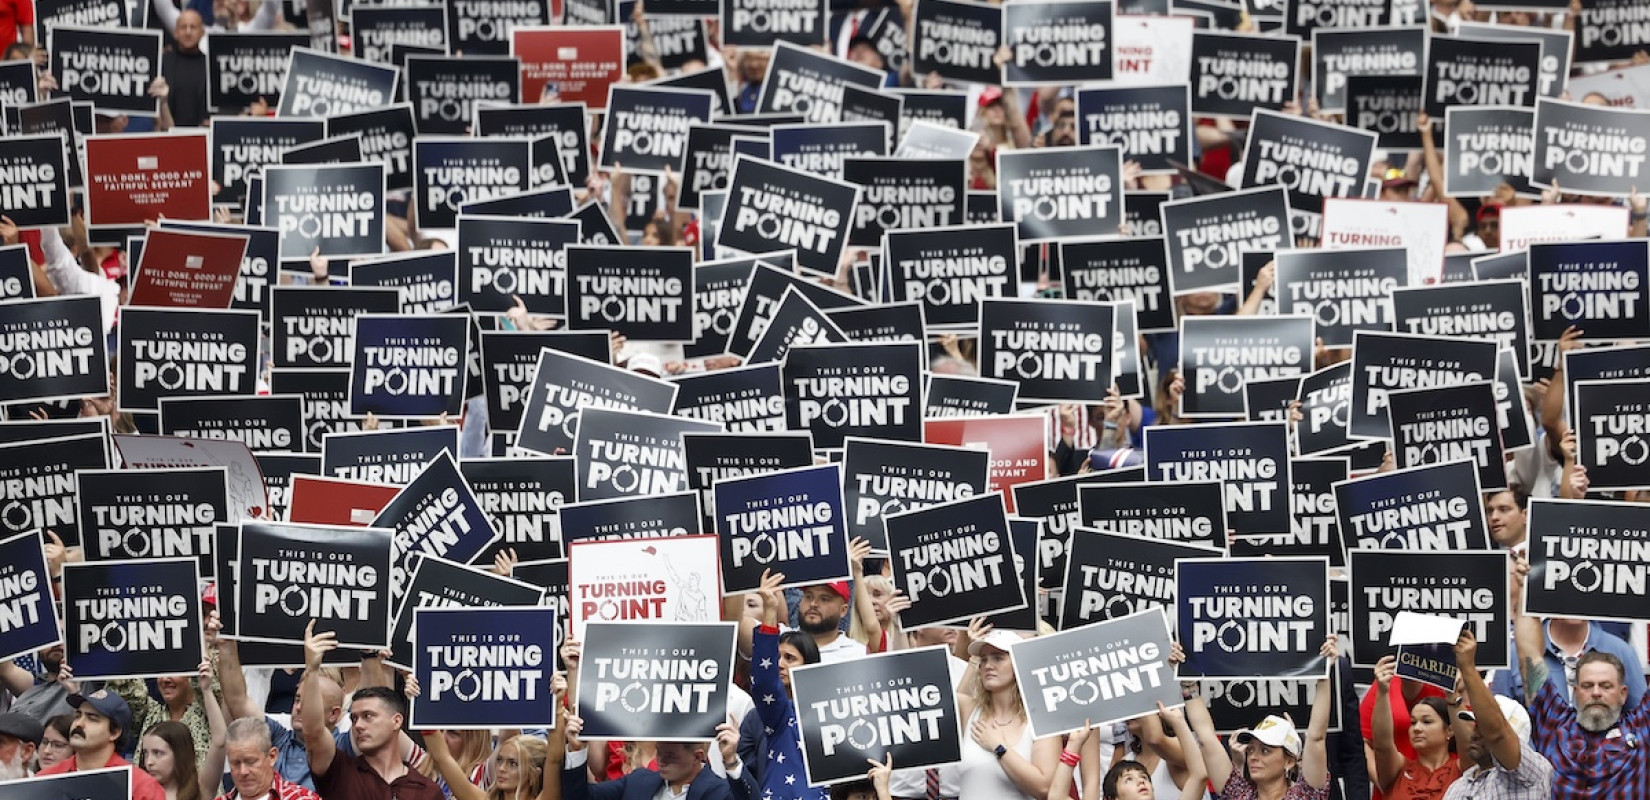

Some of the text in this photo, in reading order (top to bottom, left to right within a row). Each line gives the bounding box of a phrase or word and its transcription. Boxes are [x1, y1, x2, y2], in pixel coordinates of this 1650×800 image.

[454, 0, 541, 18] TURNING
[733, 9, 818, 33] POINT
[920, 21, 996, 46] TURNING
[1013, 24, 1104, 43] TURNING
[60, 52, 149, 73] TURNING
[920, 38, 995, 70] POINT
[1017, 42, 1105, 66] POINT
[1323, 51, 1417, 71] TURNING
[1199, 57, 1288, 78] TURNING
[1435, 64, 1530, 82] TURNING
[62, 70, 149, 97] POINT
[296, 74, 382, 107] TURNING
[417, 82, 510, 98] TURNING
[1199, 75, 1287, 103] POINT
[1437, 80, 1529, 104] POINT
[1086, 110, 1179, 131] TURNING
[1545, 129, 1647, 154] TURNING
[1259, 140, 1359, 175] TURNING
[1545, 147, 1646, 180] POINT
[94, 174, 117, 183] WELL
[152, 171, 180, 181] GOOD
[183, 170, 203, 180] AND
[104, 180, 193, 191] FAITHFUL SERVANT
[424, 166, 520, 185] TURNING
[1009, 175, 1111, 196] TURNING
[1255, 160, 1356, 200] POINT
[275, 193, 374, 213] TURNING
[853, 185, 954, 204] TURNING
[741, 186, 840, 227] TURNING
[856, 203, 955, 231] POINT
[1014, 194, 1111, 221] POINT
[278, 212, 374, 239] POINT
[735, 206, 836, 254] POINT
[1176, 216, 1280, 248] TURNING
[1330, 231, 1402, 247] TURNING
[468, 246, 564, 268] TURNING
[900, 255, 1006, 279] TURNING
[144, 268, 165, 277] WELL
[194, 273, 216, 282] GOOD
[217, 274, 233, 282] AND
[150, 278, 223, 290] FAITHFUL SERVANT
[576, 276, 682, 295] TURNING
[1071, 266, 1160, 287] TURNING
[1539, 270, 1639, 291] TURNING
[1288, 277, 1394, 300] TURNING
[581, 295, 682, 323] POINT
[1542, 291, 1640, 319] POINT
[1405, 312, 1517, 332] TURNING
[131, 340, 246, 362] TURNING
[991, 330, 1102, 352] TURNING
[364, 347, 458, 366] TURNING
[994, 350, 1102, 381] POINT
[1192, 346, 1301, 366] TURNING
[135, 361, 246, 391] POINT
[364, 366, 458, 396] POINT
[794, 375, 909, 398] TURNING
[800, 397, 910, 427] POINT
[1401, 415, 1490, 443] TURNING
[1015, 459, 1038, 467] AND
[1181, 450, 1206, 459] THIS
[1229, 448, 1251, 456] OUR
[881, 466, 907, 475] THIS
[929, 470, 951, 478] OUR
[1157, 457, 1276, 483] TURNING
[166, 494, 189, 502] OUR
[856, 474, 973, 502] TURNING
[1371, 499, 1395, 509] THIS
[1418, 490, 1440, 500] OUR
[746, 500, 768, 509] THIS
[788, 493, 808, 503] OUR
[92, 503, 215, 526] TURNING
[726, 501, 832, 535] TURNING
[1350, 496, 1469, 535] TURNING
[99, 526, 214, 556] POINT
[917, 533, 939, 543] THIS
[957, 524, 975, 535] OUR
[279, 550, 352, 561] THIS IS OUR
[732, 525, 834, 566] POINT
[899, 531, 1000, 570] TURNING
[252, 559, 377, 587] TURNING
[907, 554, 1003, 602] POINT
[1425, 577, 1435, 585] IS
[1443, 577, 1466, 585] OUR
[97, 588, 120, 596] THIS
[142, 585, 162, 594] OUR
[578, 580, 666, 598] TURNING
[1214, 586, 1240, 594] THIS
[1264, 585, 1287, 593] OUR
[1364, 587, 1493, 610] TURNING
[75, 594, 187, 620] TURNING
[255, 583, 376, 621] POINT
[582, 597, 667, 621] POINT
[1188, 595, 1313, 618] TURNING
[80, 619, 188, 652] POINT
[1193, 619, 1314, 652] POINT
[427, 645, 542, 667] TURNING
[1055, 650, 1082, 662] THIS
[1106, 639, 1129, 649] OUR
[594, 658, 718, 680] TURNING
[1031, 642, 1160, 686] TURNING
[1400, 652, 1457, 679] CHARLIE
[430, 668, 542, 701] POINT
[836, 684, 864, 695] THIS
[889, 677, 912, 687] OUR
[1042, 661, 1164, 713] POINT
[594, 680, 716, 713] POINT
[810, 684, 941, 722] TURNING
[820, 708, 944, 755] POINT
